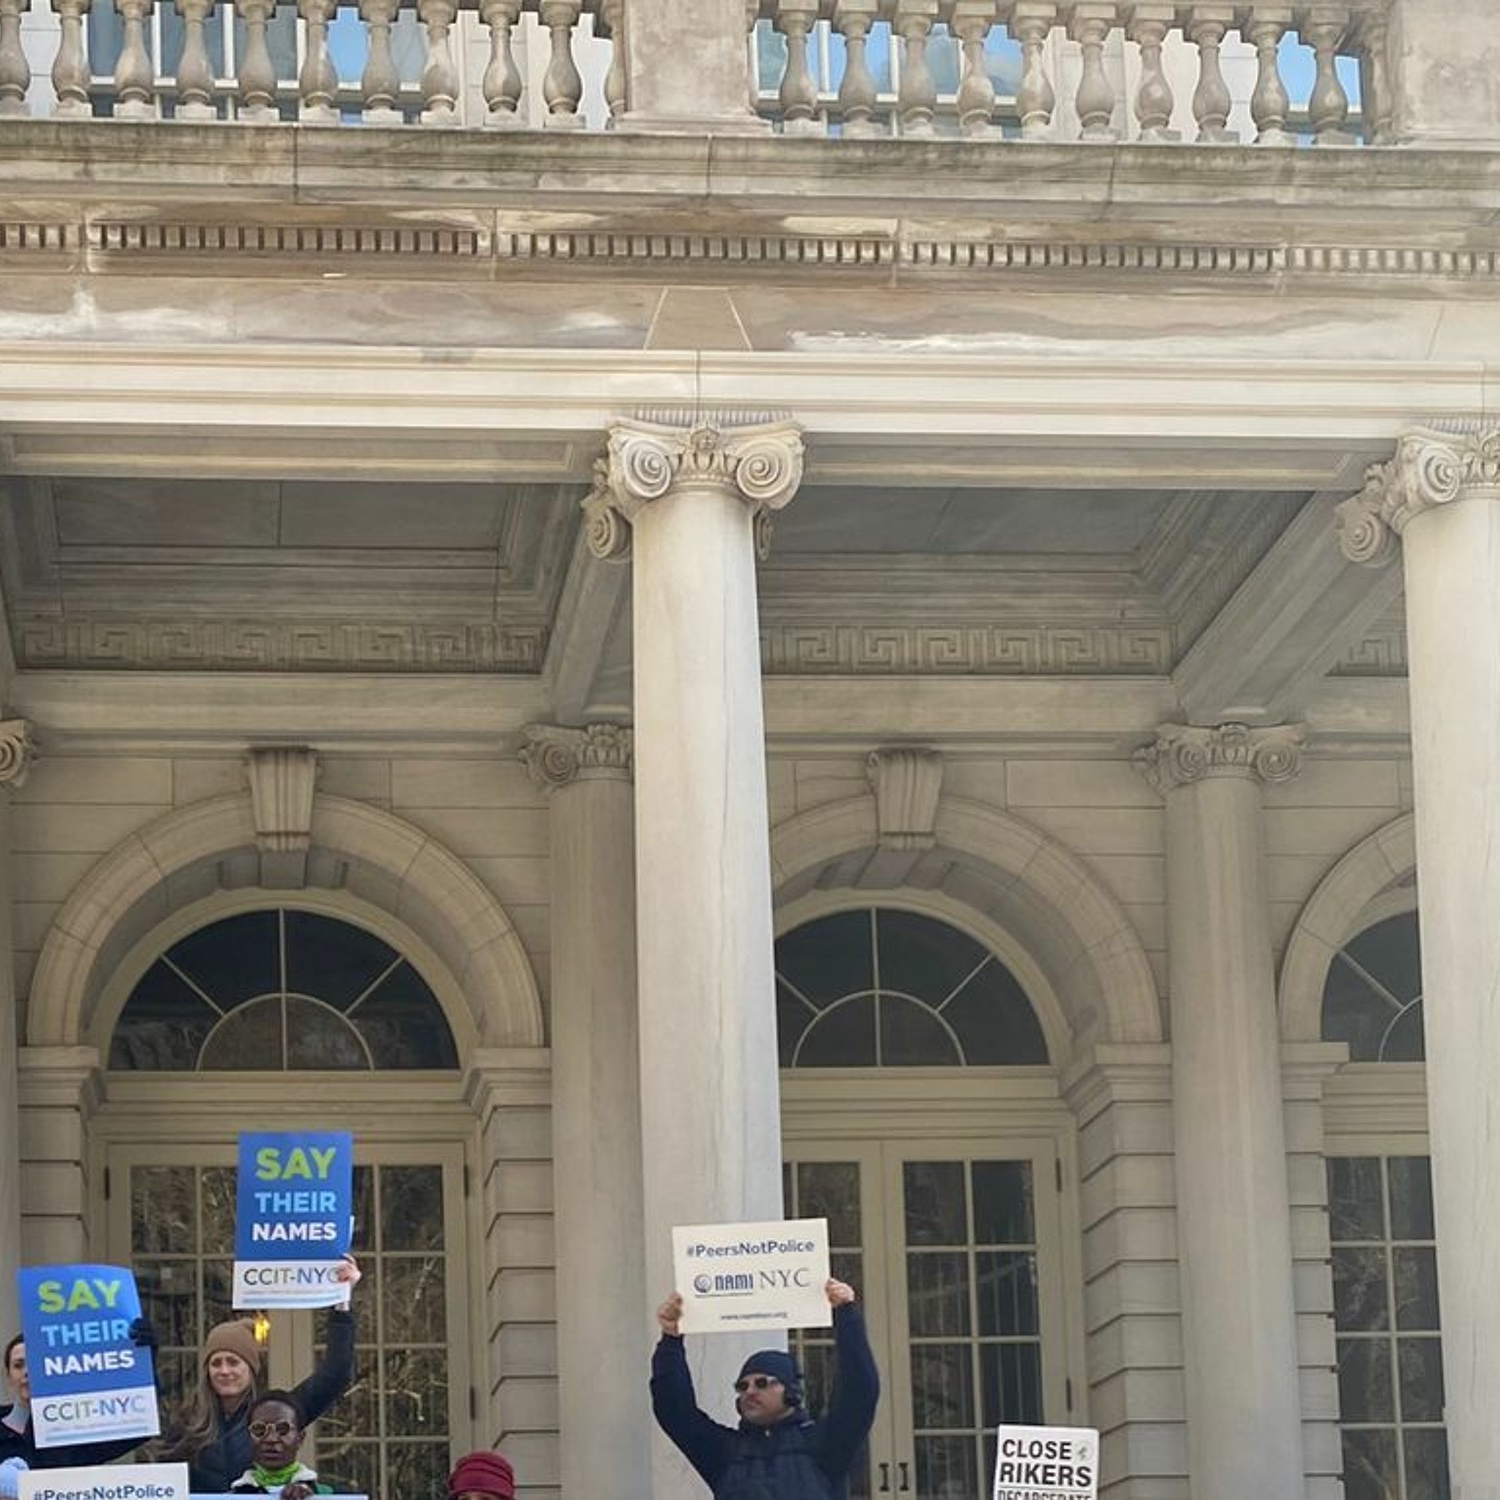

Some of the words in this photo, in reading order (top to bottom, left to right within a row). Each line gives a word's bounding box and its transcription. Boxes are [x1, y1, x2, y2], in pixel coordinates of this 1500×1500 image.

[255, 1147, 337, 1180] SAY
[254, 1192, 337, 1213] THEIR
[252, 1222, 338, 1241] NAMES
[687, 1239, 815, 1258] #PeersNotPolice
[714, 1273, 754, 1291] NAMI
[759, 1267, 810, 1290] NYC
[37, 1279, 121, 1314] SAY
[41, 1319, 129, 1347] THEIR
[44, 1349, 136, 1377] NAMES
[42, 1395, 146, 1423] CCIT-NYC
[1002, 1438, 1073, 1461] CLOSE
[999, 1462, 1093, 1488] RIKERS
